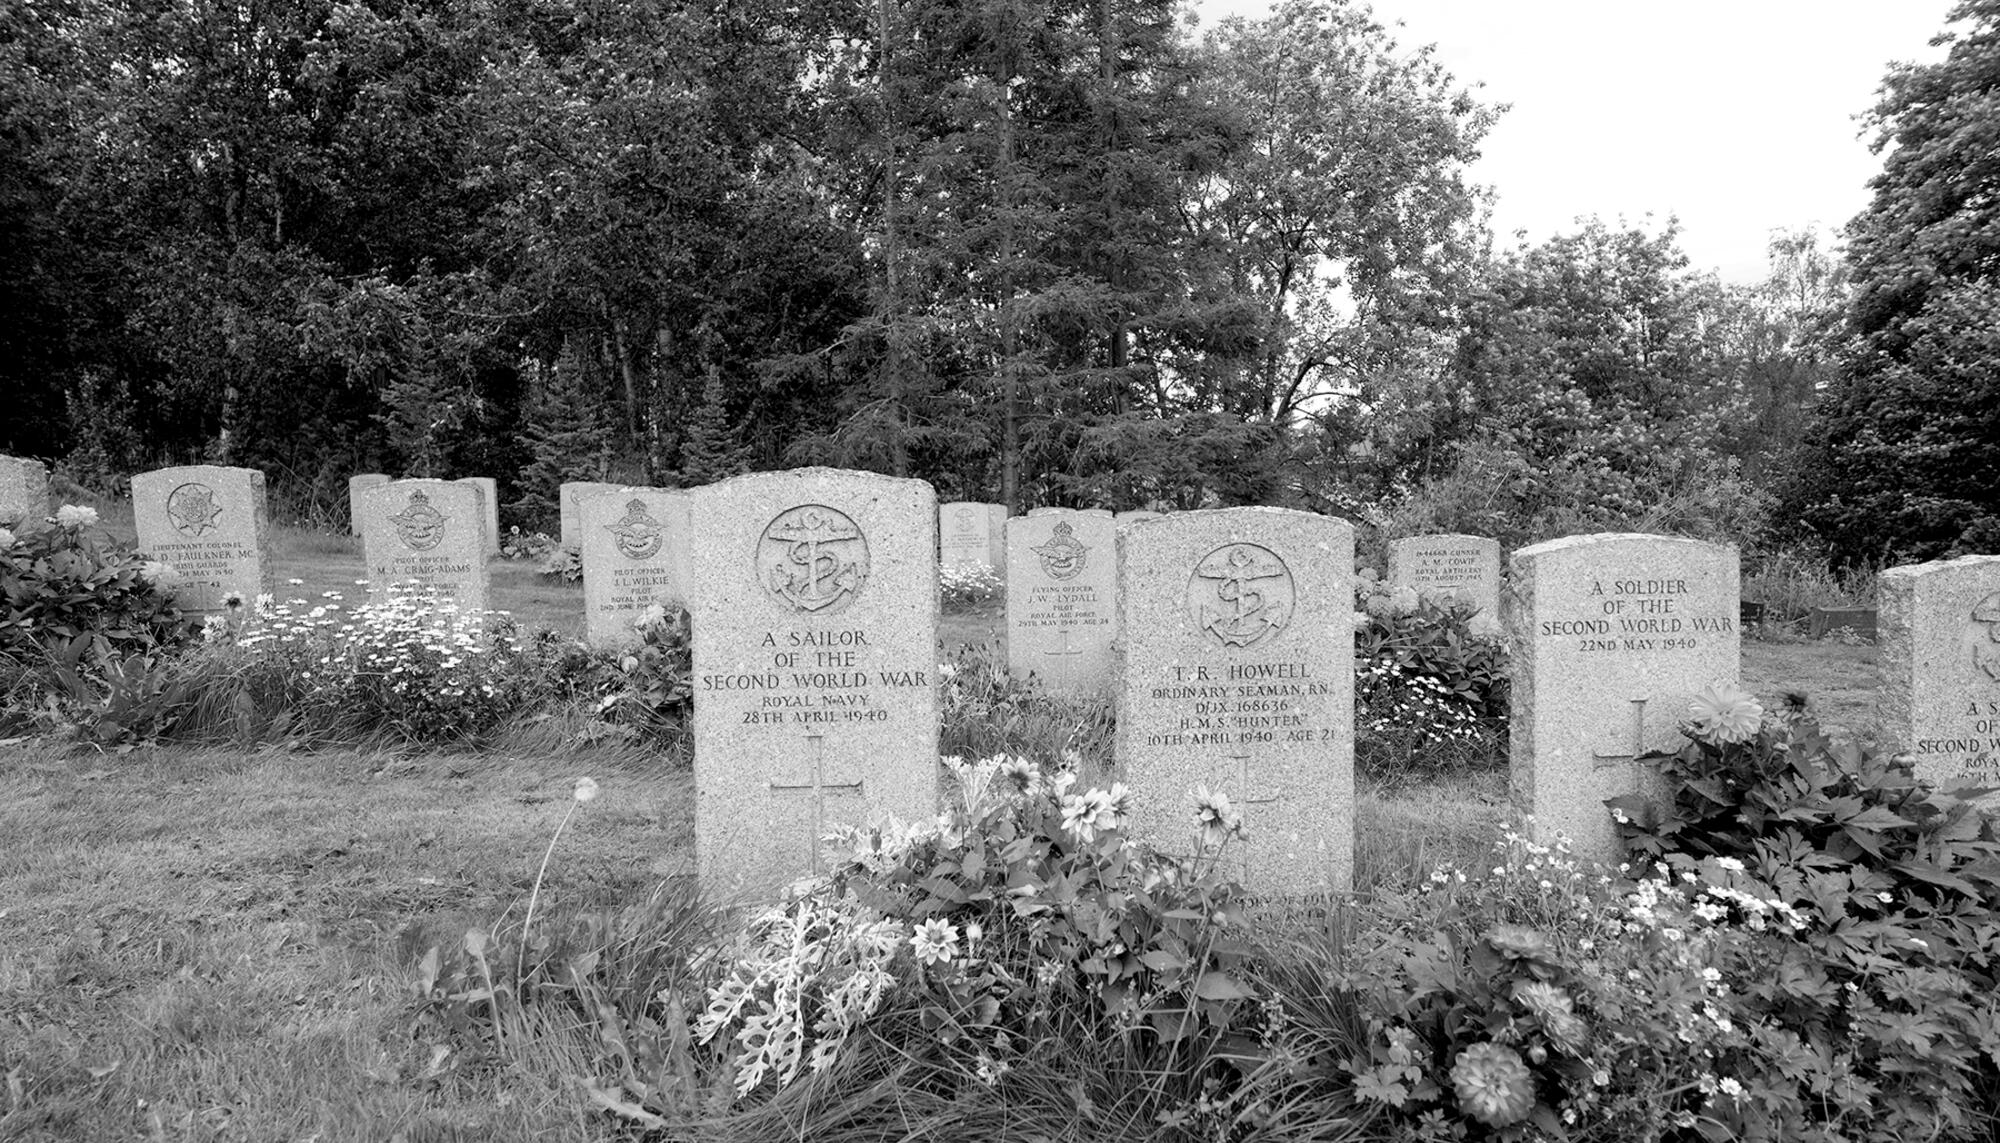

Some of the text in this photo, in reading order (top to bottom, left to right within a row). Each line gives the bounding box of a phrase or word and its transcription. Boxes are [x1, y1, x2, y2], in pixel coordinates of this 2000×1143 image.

[1450, 549, 1481, 557] GUNNER
[197, 561, 228, 569] GUARDS
[404, 564, 471, 575] CRAIG-ADAMS
[637, 567, 665, 575] OFFICER
[632, 576, 669, 586] WILKIE
[1590, 580, 1688, 595] A SOLDIER
[1058, 594, 1098, 603] LYDALL
[1603, 599, 1674, 614] OF THE
[1541, 617, 1733, 636] SECOND WORLD WAR
[761, 631, 867, 647] A SAILOR
[1579, 638, 1697, 651] 22ND MAY 1940
[774, 651, 856, 667] OF THE
[1230, 664, 1311, 680] HOWELL
[703, 672, 928, 691] SECOND WORLD WAR
[1152, 687, 1229, 699] ORDINARY
[762, 694, 870, 707] ROYAL NAVY
[1966, 702, 1979, 715] A
[742, 710, 888, 724] 28TH APRIL 1940
[1976, 719, 2000, 734] OF
[1148, 729, 1335, 746] 10TH APRIL 1940 AGE 21
[1917, 739, 1980, 754] SECOND
